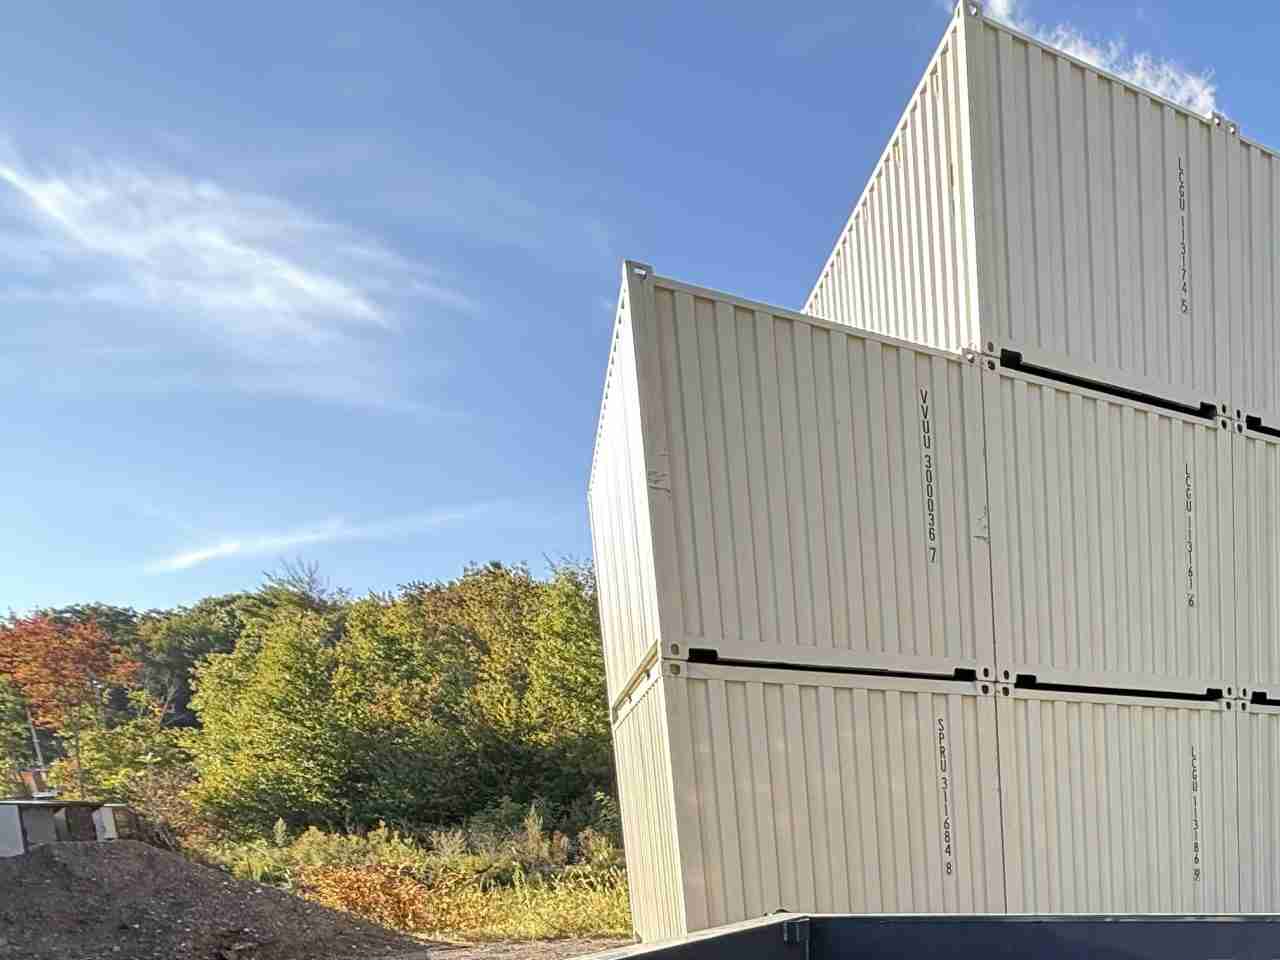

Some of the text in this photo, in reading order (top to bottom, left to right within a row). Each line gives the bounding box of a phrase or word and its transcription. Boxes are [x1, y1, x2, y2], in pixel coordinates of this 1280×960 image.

[919, 388, 937, 564] VVUU 300036 7
[937, 718, 953, 876] SPRU 311684 8
